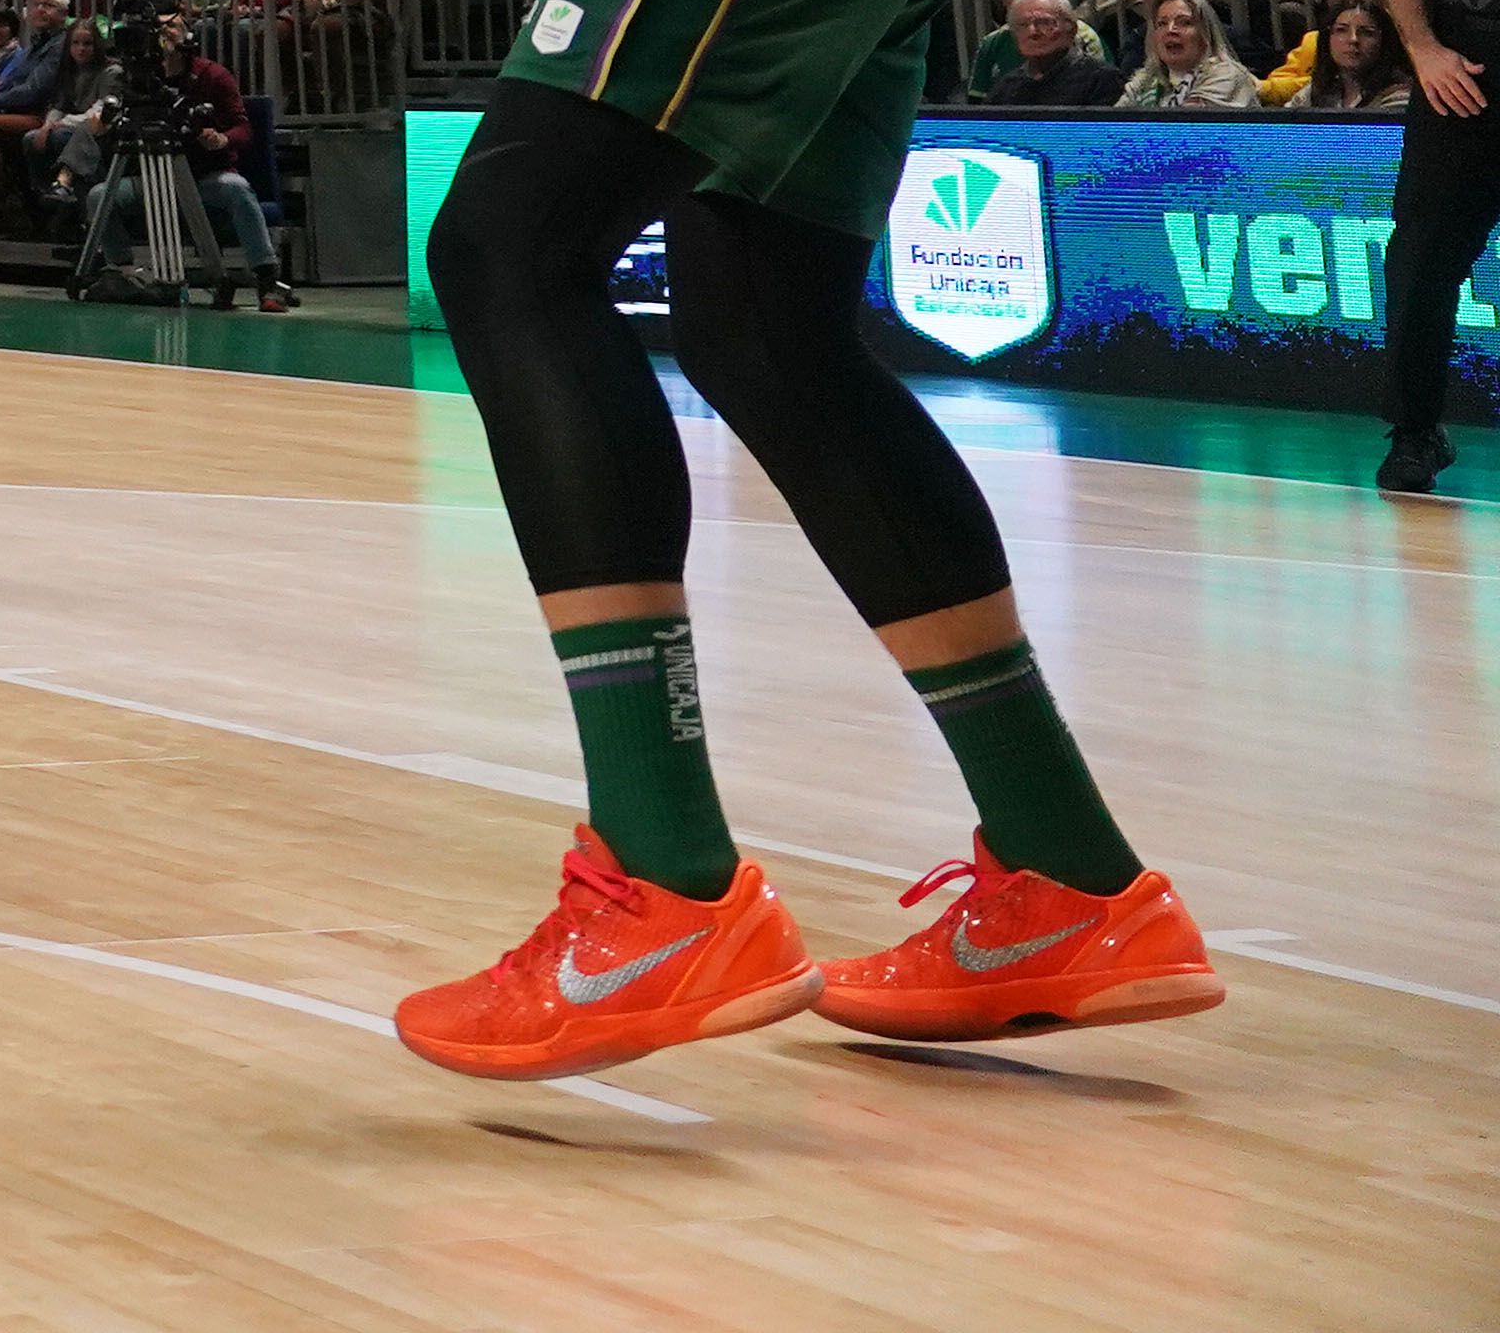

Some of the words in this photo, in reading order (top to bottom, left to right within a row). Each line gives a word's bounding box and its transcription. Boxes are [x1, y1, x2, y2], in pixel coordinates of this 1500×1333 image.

[911, 245, 1023, 269] Fundación
[930, 274, 1010, 299] Unicaja
[663, 645, 703, 742] UNICAJA
